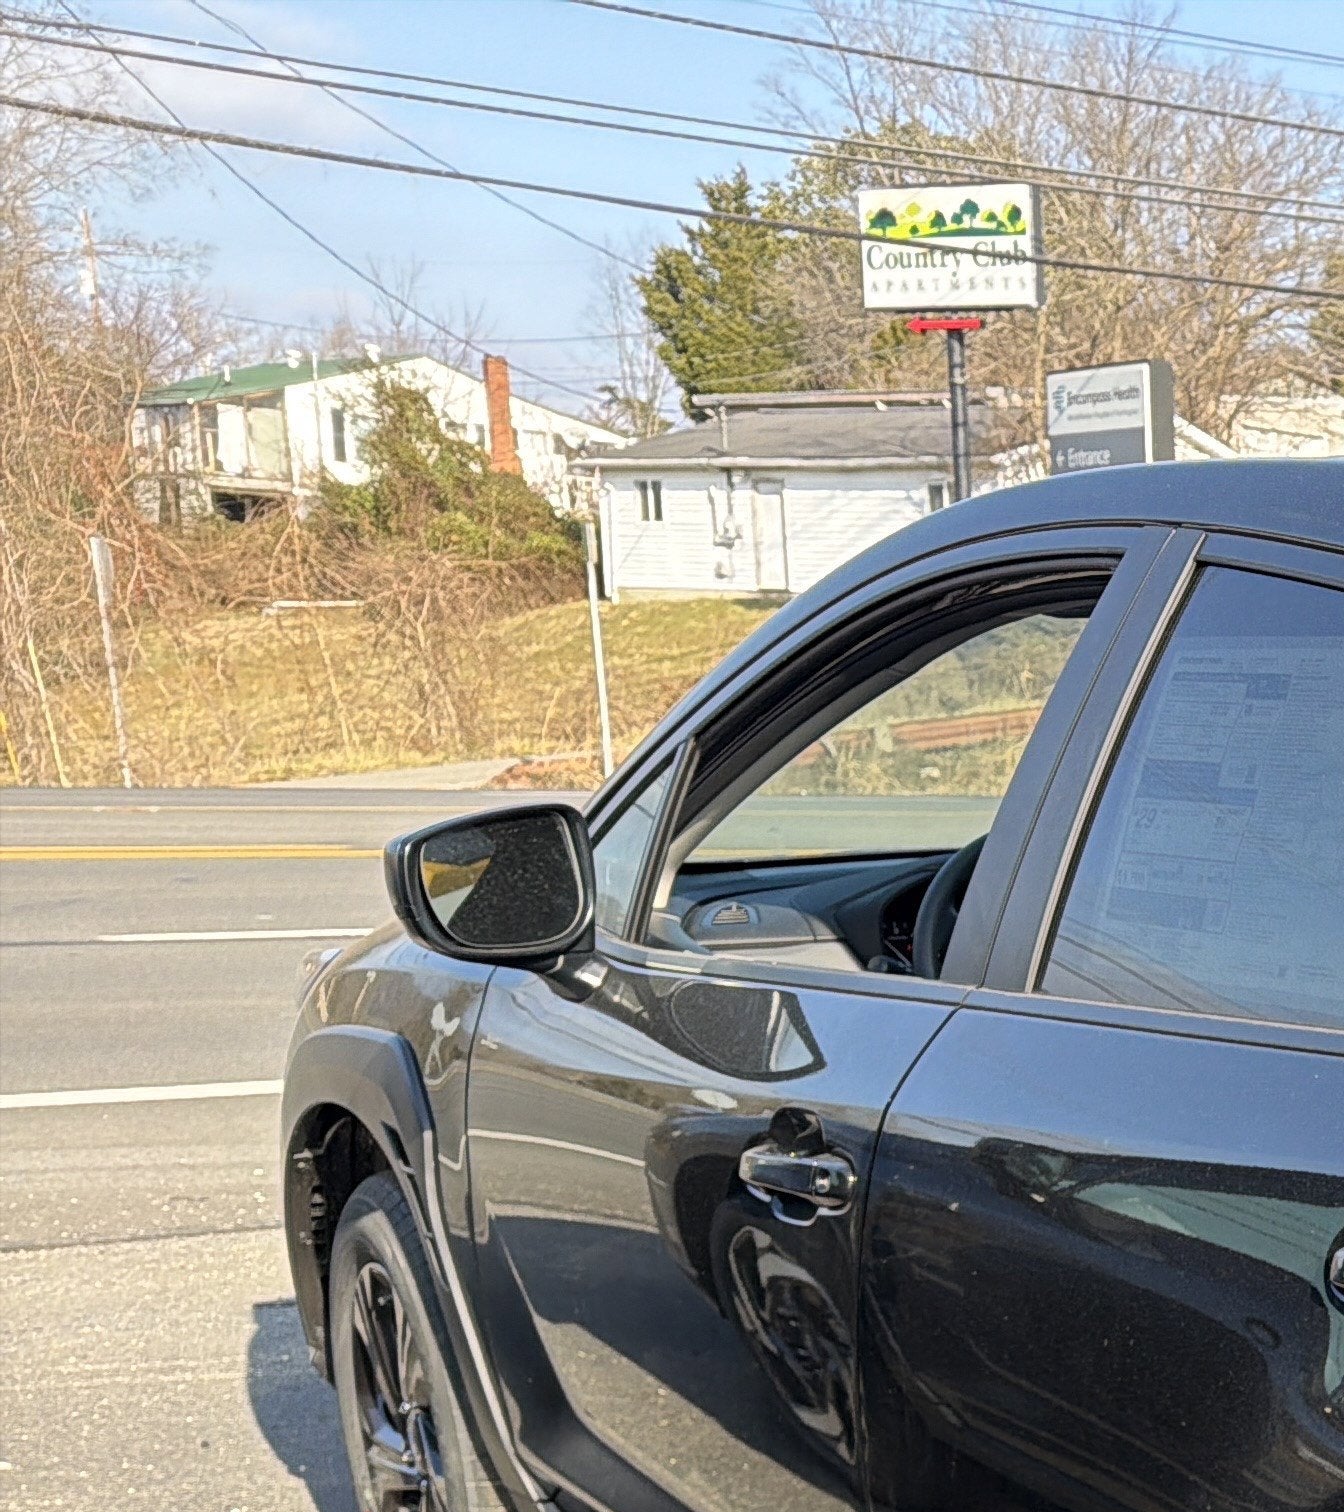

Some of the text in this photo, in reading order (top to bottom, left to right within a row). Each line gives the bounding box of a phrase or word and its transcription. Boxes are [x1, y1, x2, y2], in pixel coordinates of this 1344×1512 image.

[866, 240, 1027, 277] Country Club
[871, 276, 1027, 293] APARTMENTS
